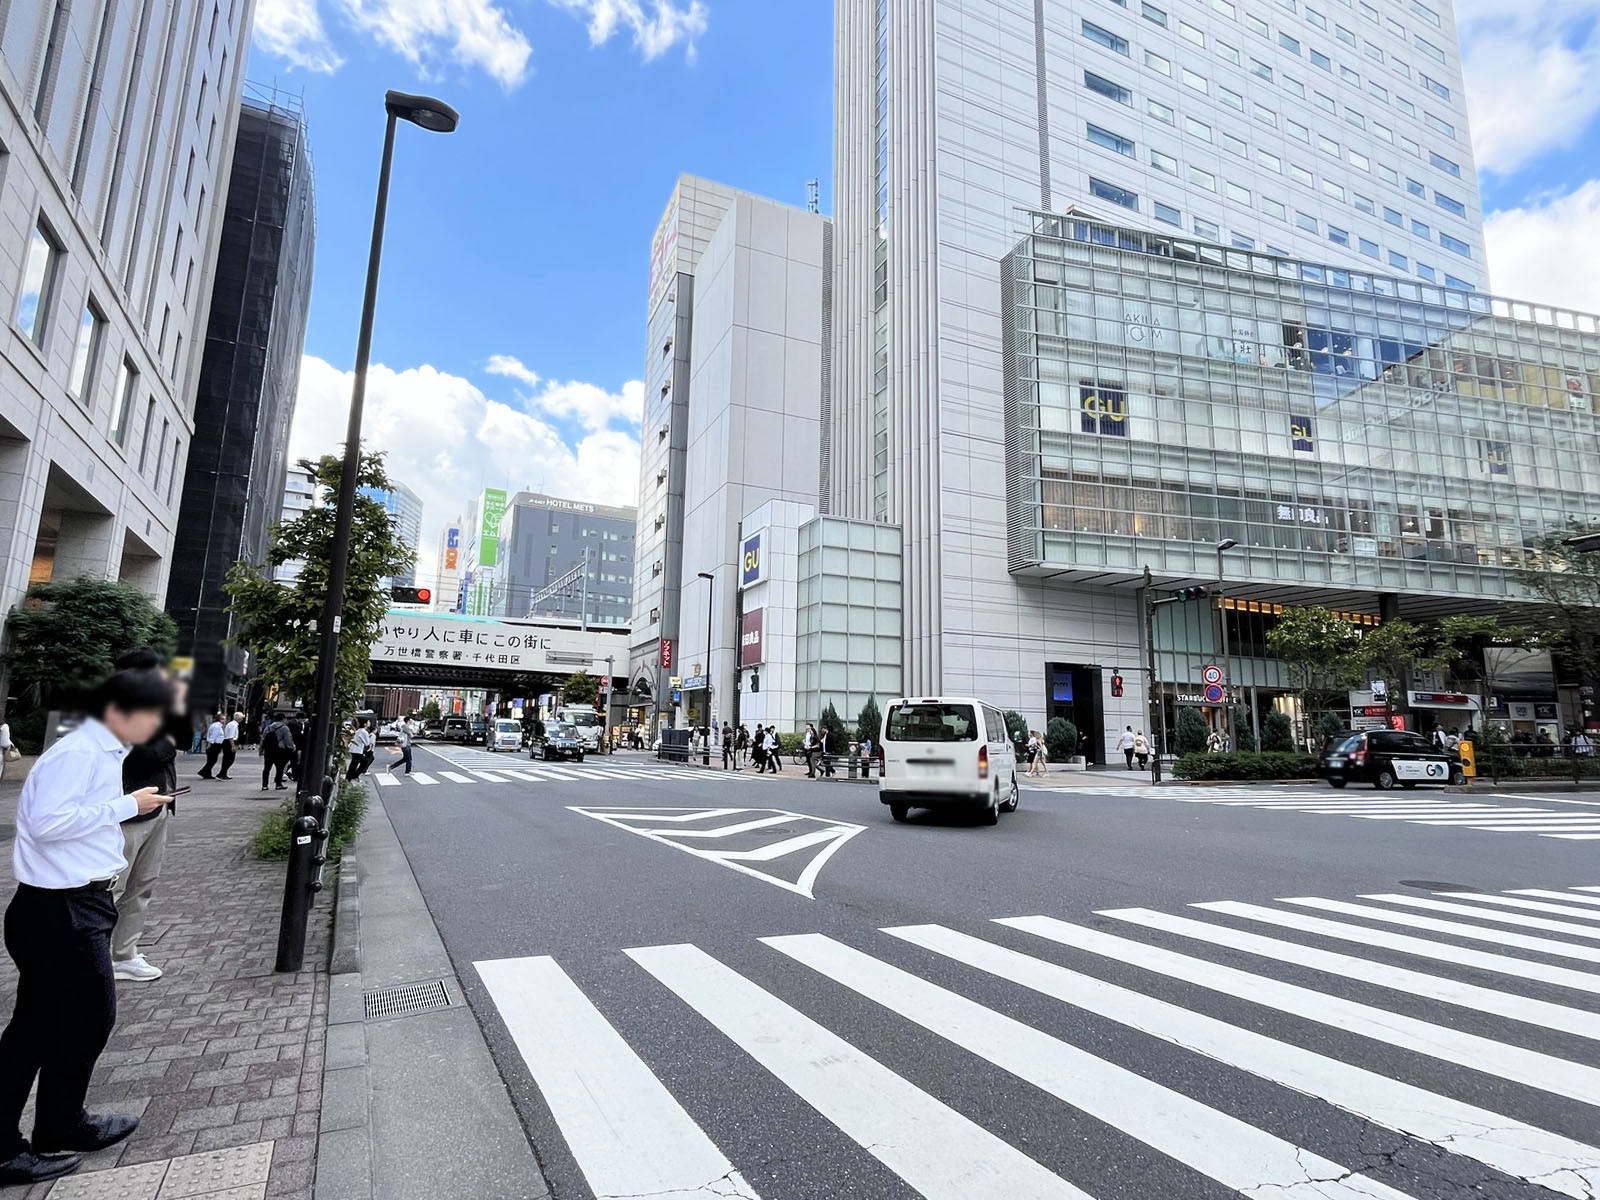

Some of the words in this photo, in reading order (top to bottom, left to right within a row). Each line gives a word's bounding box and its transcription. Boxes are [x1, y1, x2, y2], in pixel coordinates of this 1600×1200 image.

[1084, 395, 1125, 422] GU
[546, 499, 573, 509] HOTEL
[573, 503, 594, 512] METS
[744, 547, 760, 573] GU
[1208, 672, 1218, 680] 40
[1176, 694, 1209, 703] STARBUC
[1425, 764, 1444, 777] GO
